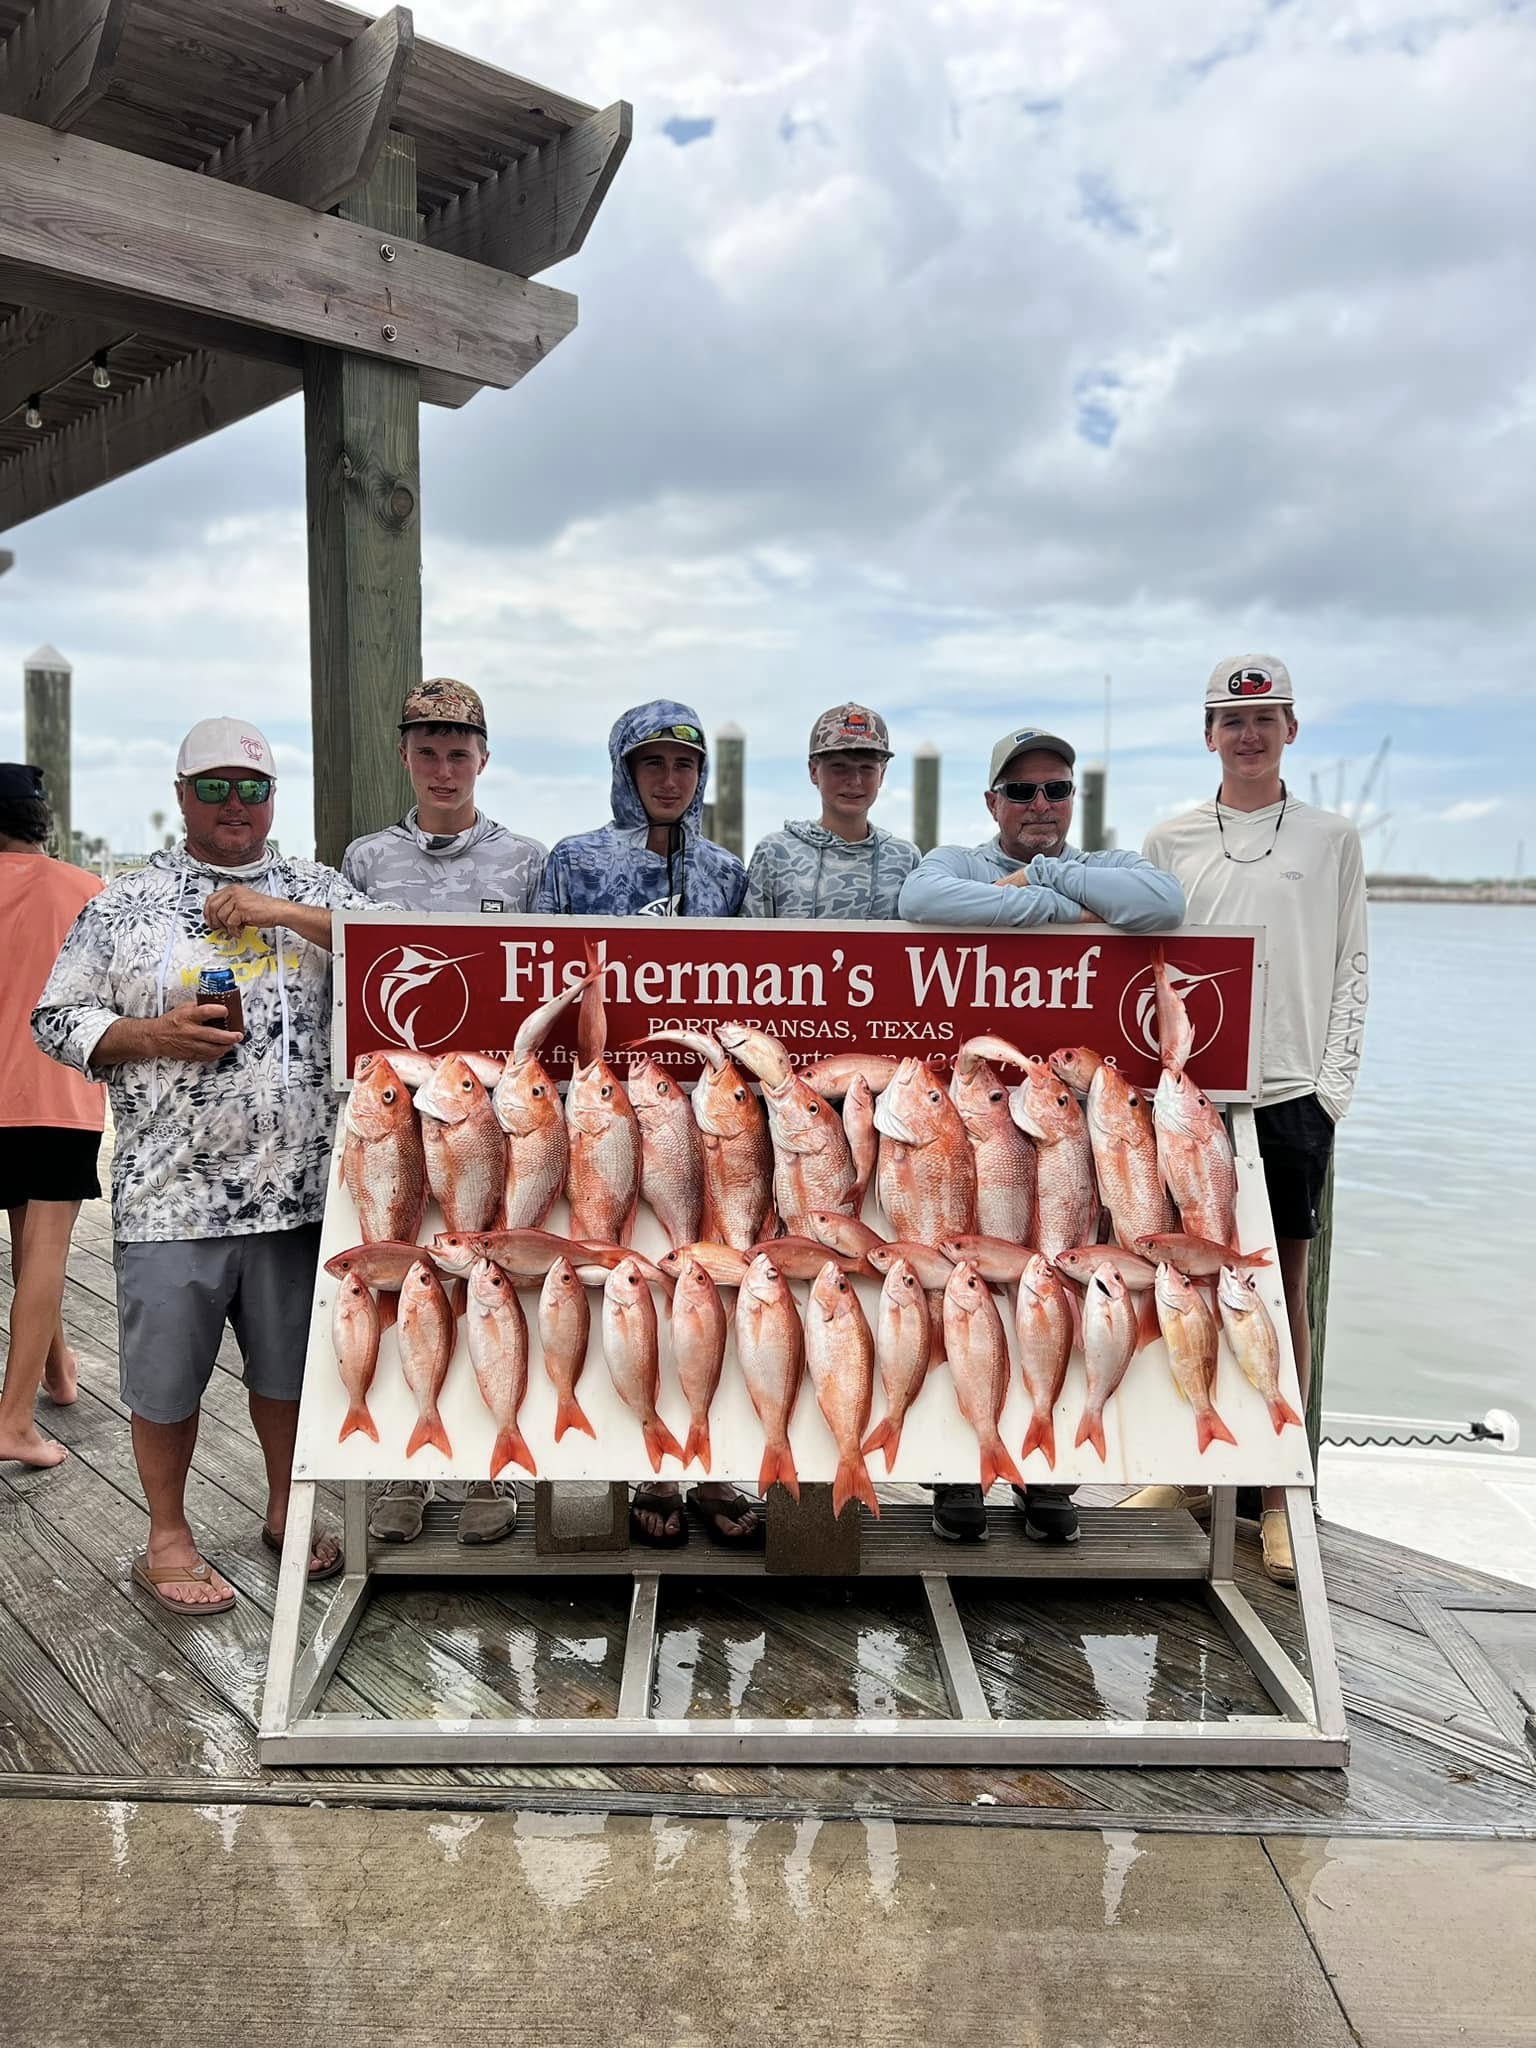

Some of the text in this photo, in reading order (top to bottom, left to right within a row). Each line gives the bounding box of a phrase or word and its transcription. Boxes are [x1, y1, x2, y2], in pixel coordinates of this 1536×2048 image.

[499, 939, 1102, 1009] Fisherman's Wharf
[647, 1018, 954, 1042] PORT RANSAS, TEXAS
